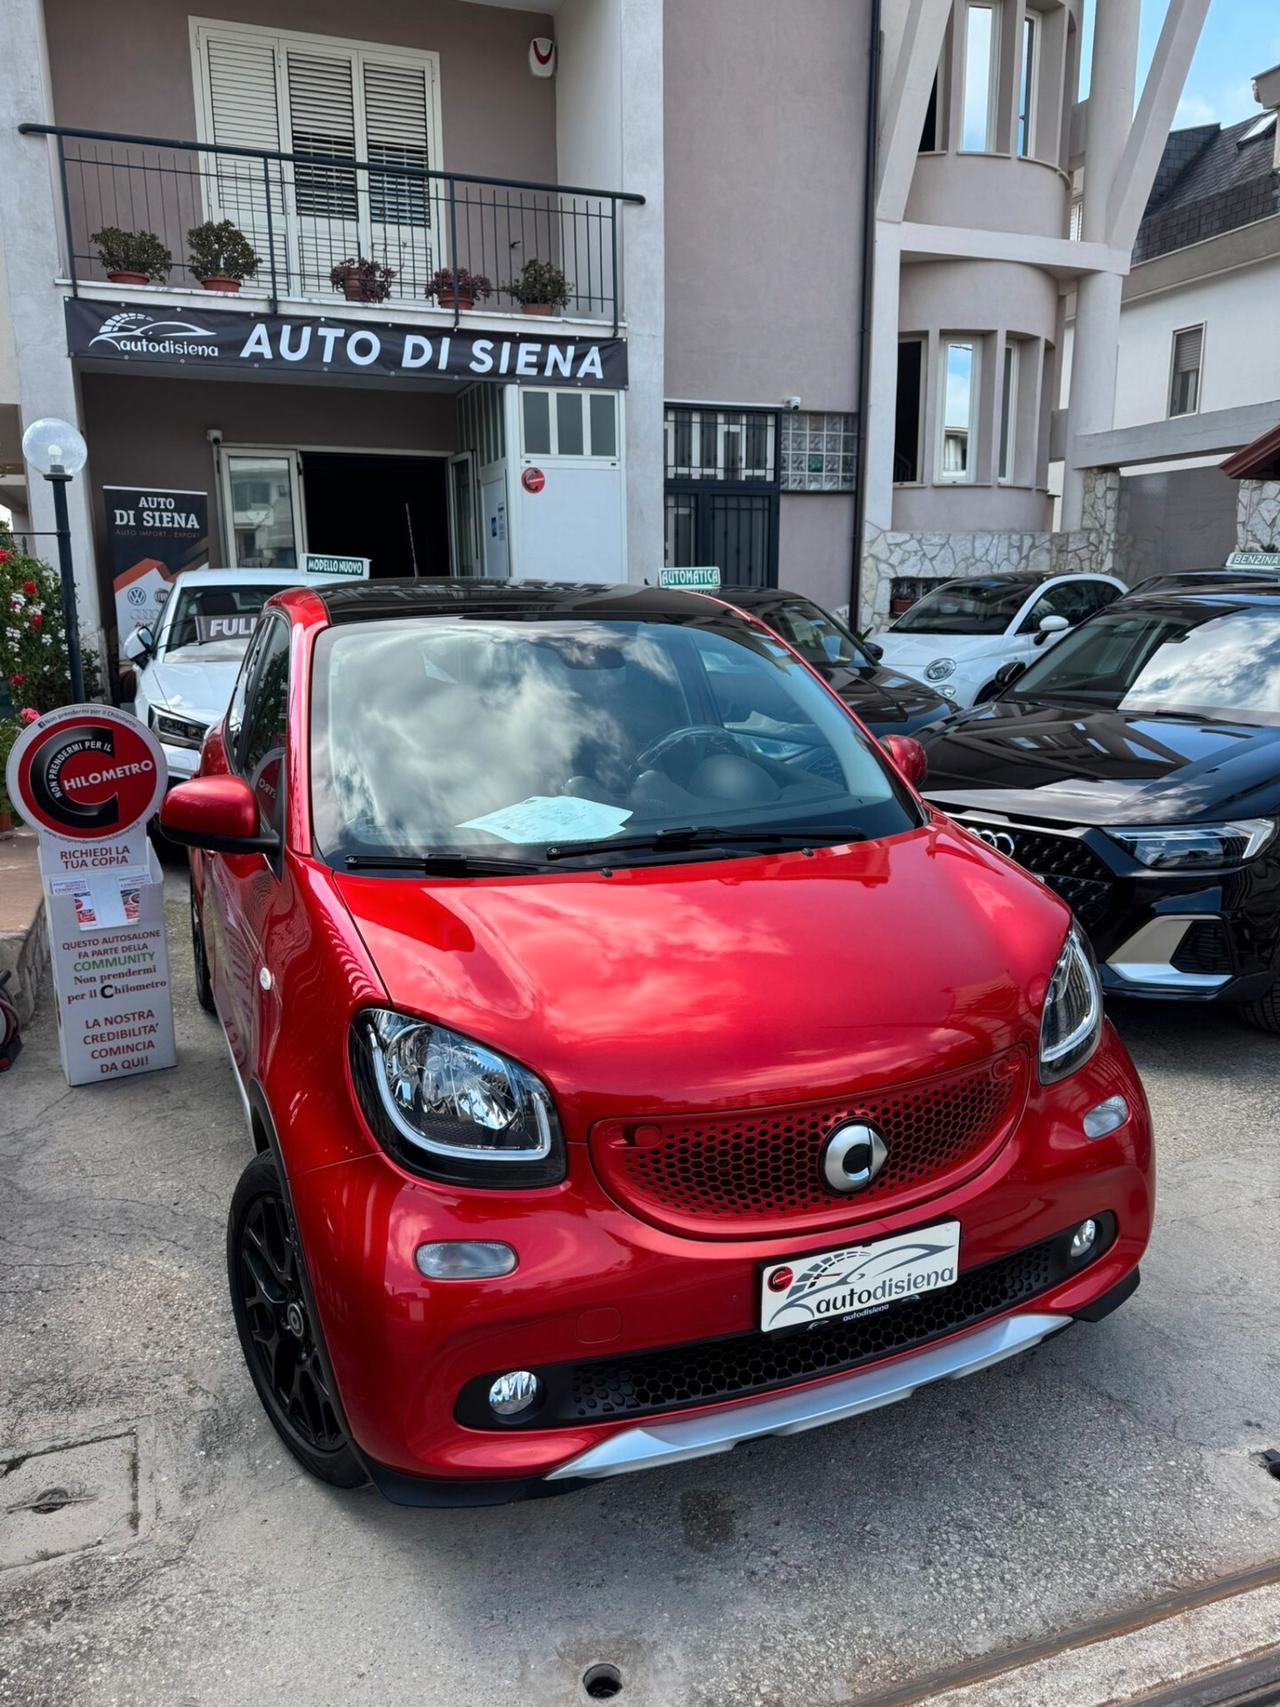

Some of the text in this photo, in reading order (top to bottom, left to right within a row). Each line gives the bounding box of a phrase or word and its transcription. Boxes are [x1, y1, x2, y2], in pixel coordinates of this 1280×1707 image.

[119, 339, 219, 358] autodisiena
[239, 323, 604, 379] AUTO DI SIENA
[138, 496, 175, 509] AUTO
[114, 509, 200, 529] DI SIENA
[115, 529, 137, 537] AUTO
[174, 531, 200, 539] EXPORT
[308, 559, 362, 574] MODELLO NUOVO
[1234, 554, 1279, 565] BENZINA
[662, 570, 718, 585] AUTOMATICA
[49, 740, 112, 798] NON PRENDERMI PER IL
[60, 845, 130, 860] RICHIEDI LA
[63, 855, 129, 870] TUA COPIA
[62, 930, 161, 950] QUESTO AUTOSALONE
[78, 943, 149, 959] FA PARTE DELLA
[73, 952, 156, 973] COMMUNITY
[74, 965, 157, 985] Non prendermi
[67, 980, 167, 1005] per il Chilometro
[85, 1009, 155, 1029] LA NOSTRA
[91, 1040, 155, 1060] COMINCIA
[100, 1056, 149, 1073] DA QUI!
[815, 1265, 954, 1314] autodisiena
[842, 1304, 890, 1322] autodisiena
